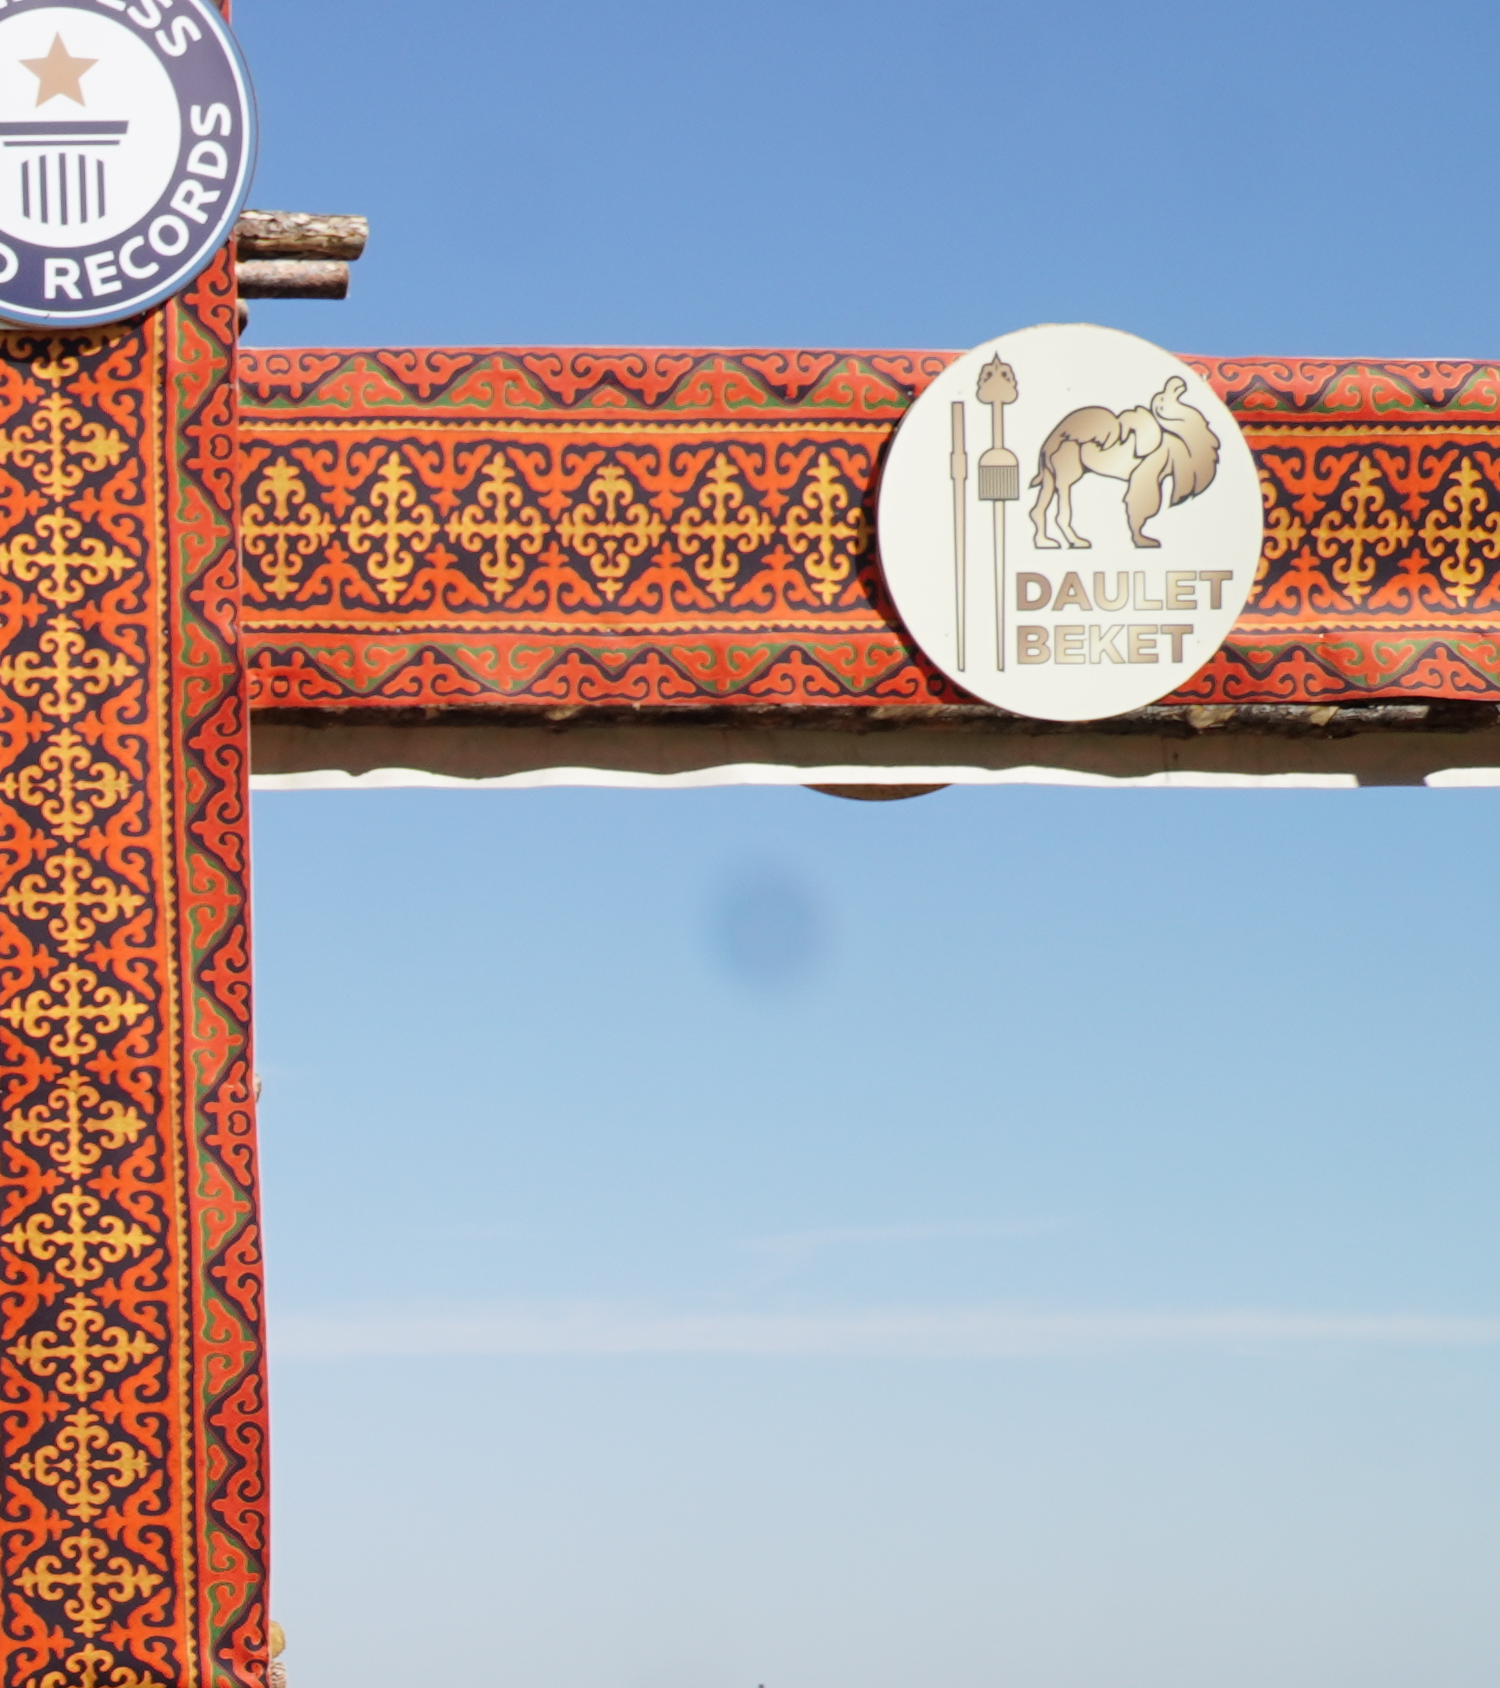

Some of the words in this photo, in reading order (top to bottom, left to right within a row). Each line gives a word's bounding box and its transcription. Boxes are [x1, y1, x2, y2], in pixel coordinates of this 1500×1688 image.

[44, 102, 232, 299] RECORDS
[1016, 570, 1233, 611] DAULET
[1017, 624, 1194, 664] BEKET
